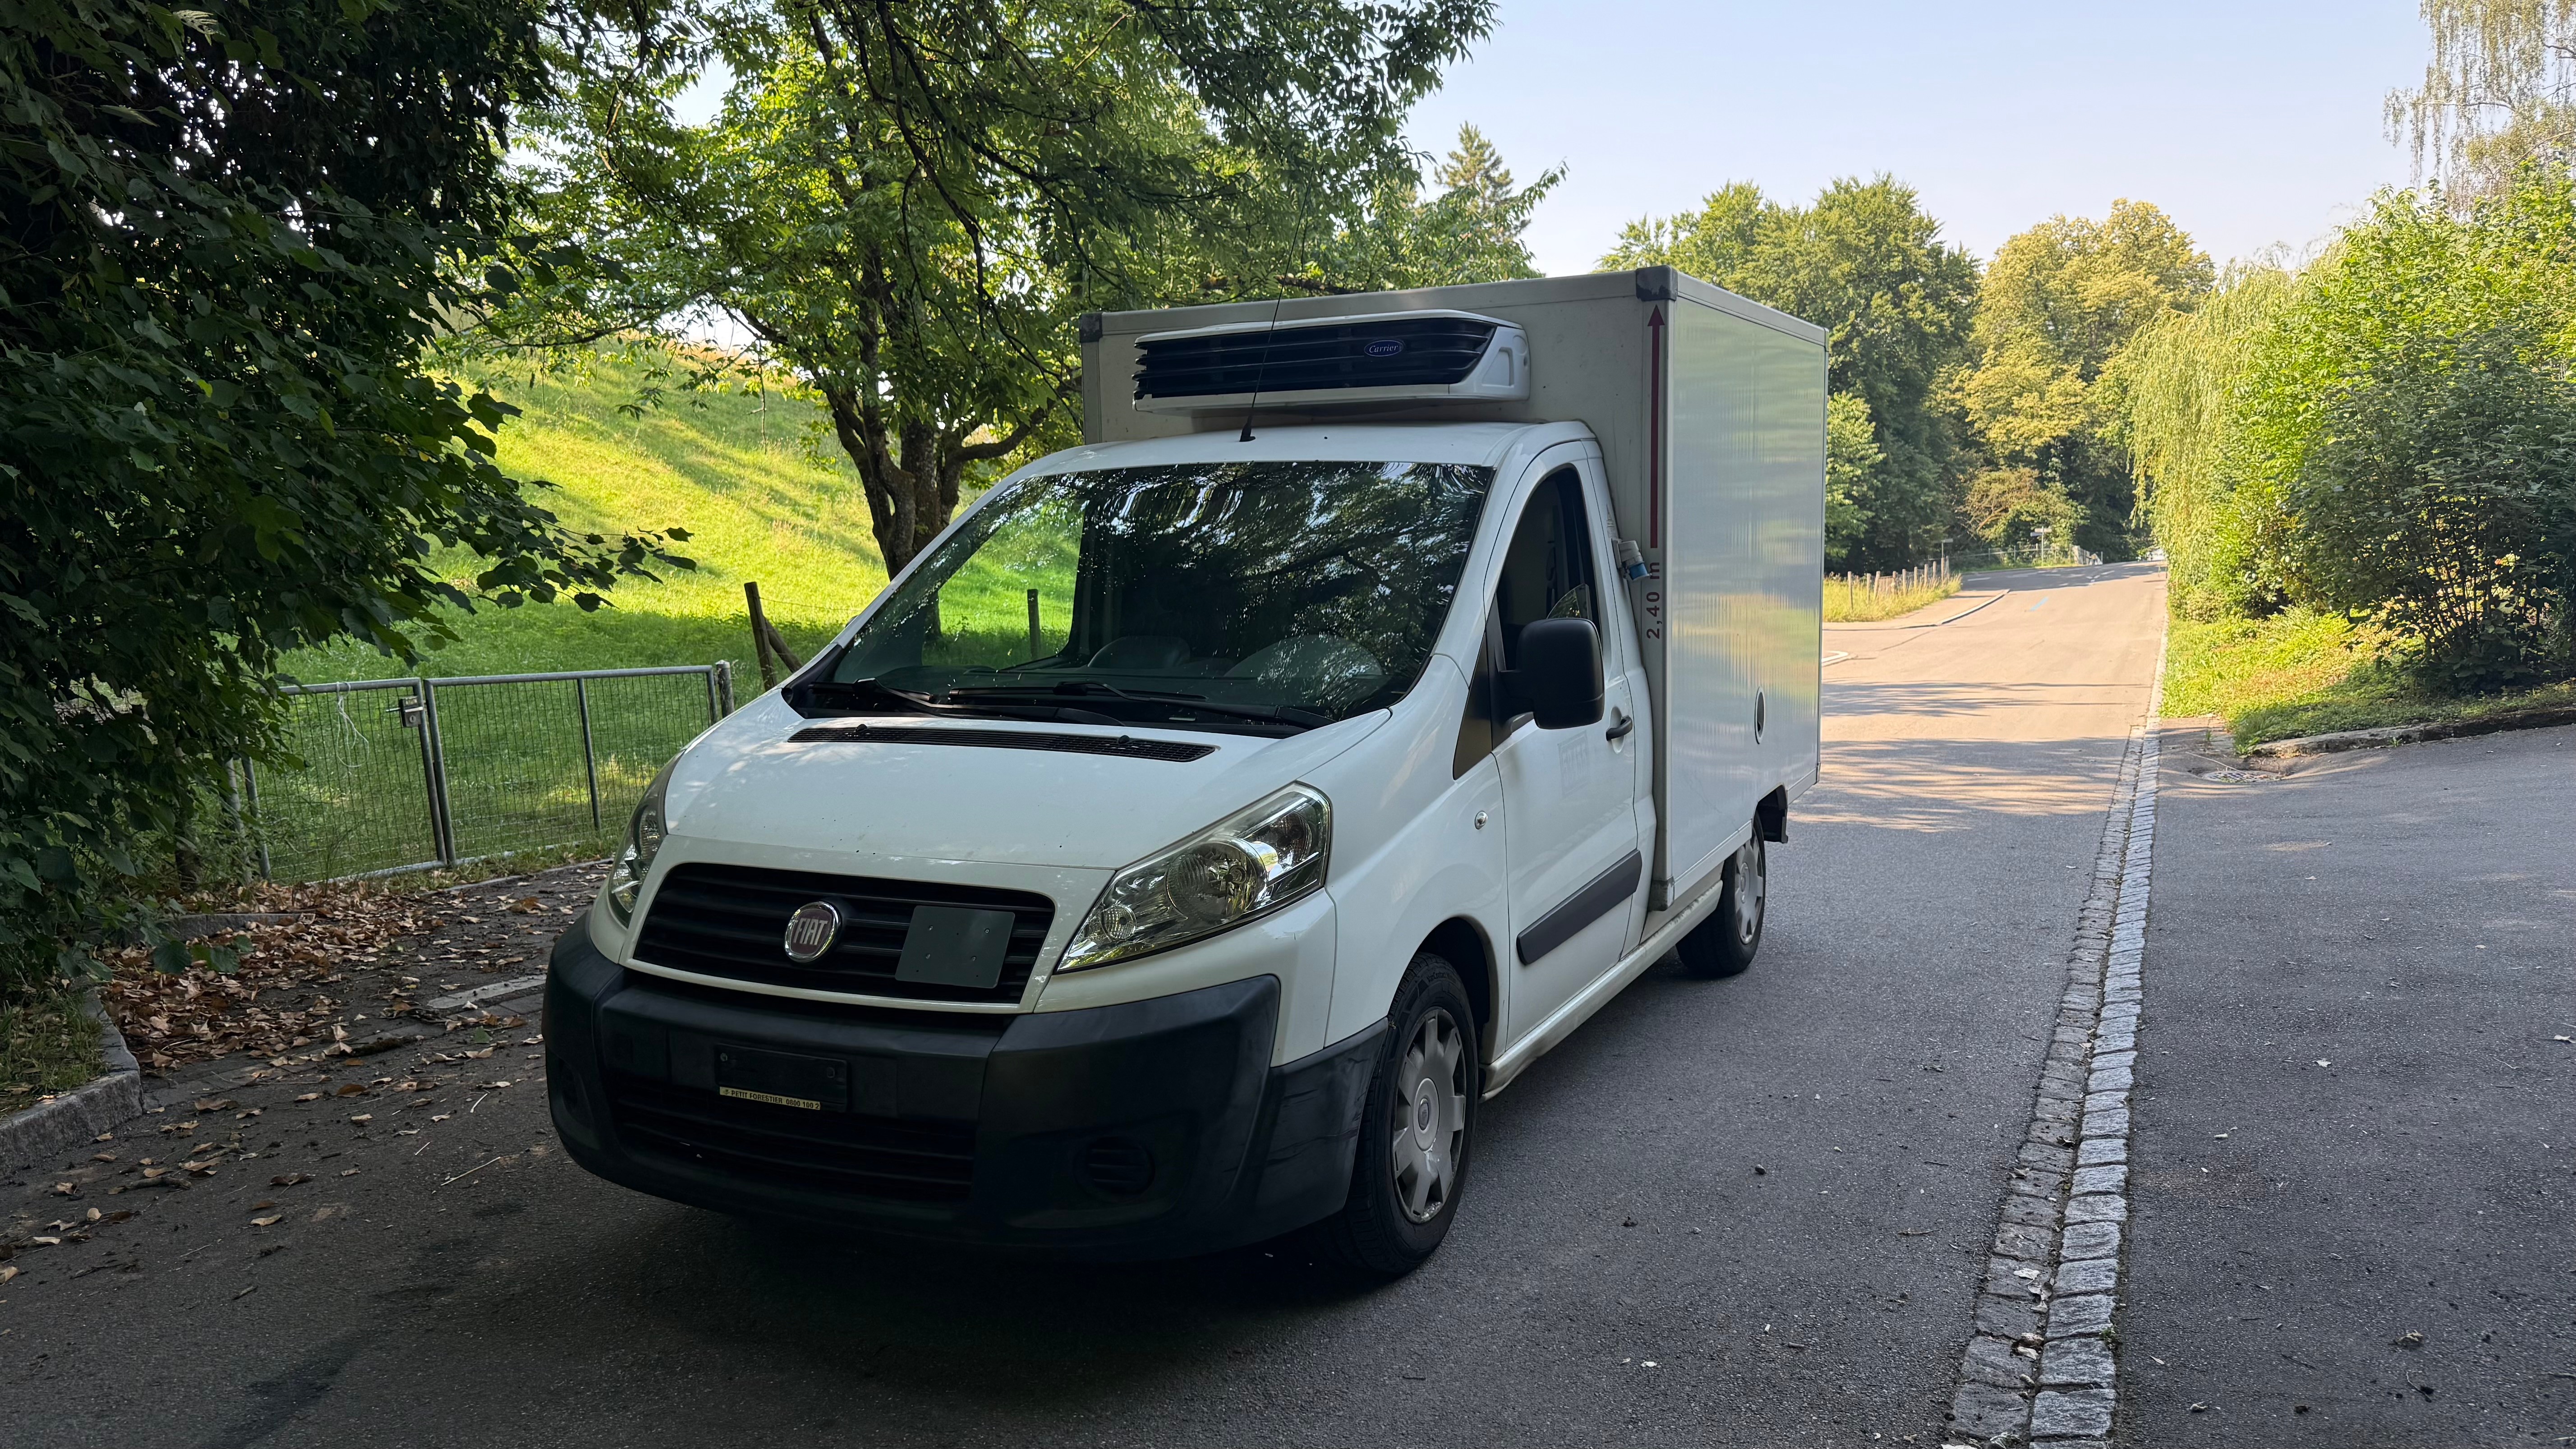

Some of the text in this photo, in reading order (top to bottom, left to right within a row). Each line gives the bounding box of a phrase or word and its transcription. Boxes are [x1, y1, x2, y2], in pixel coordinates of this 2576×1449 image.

[1369, 345, 1398, 353] Carrier
[1646, 562, 1662, 639] 2,40 m
[793, 918, 828, 945] FIAT
[731, 1090, 747, 1098] PETIT
[750, 1093, 782, 1104] FORESTIER
